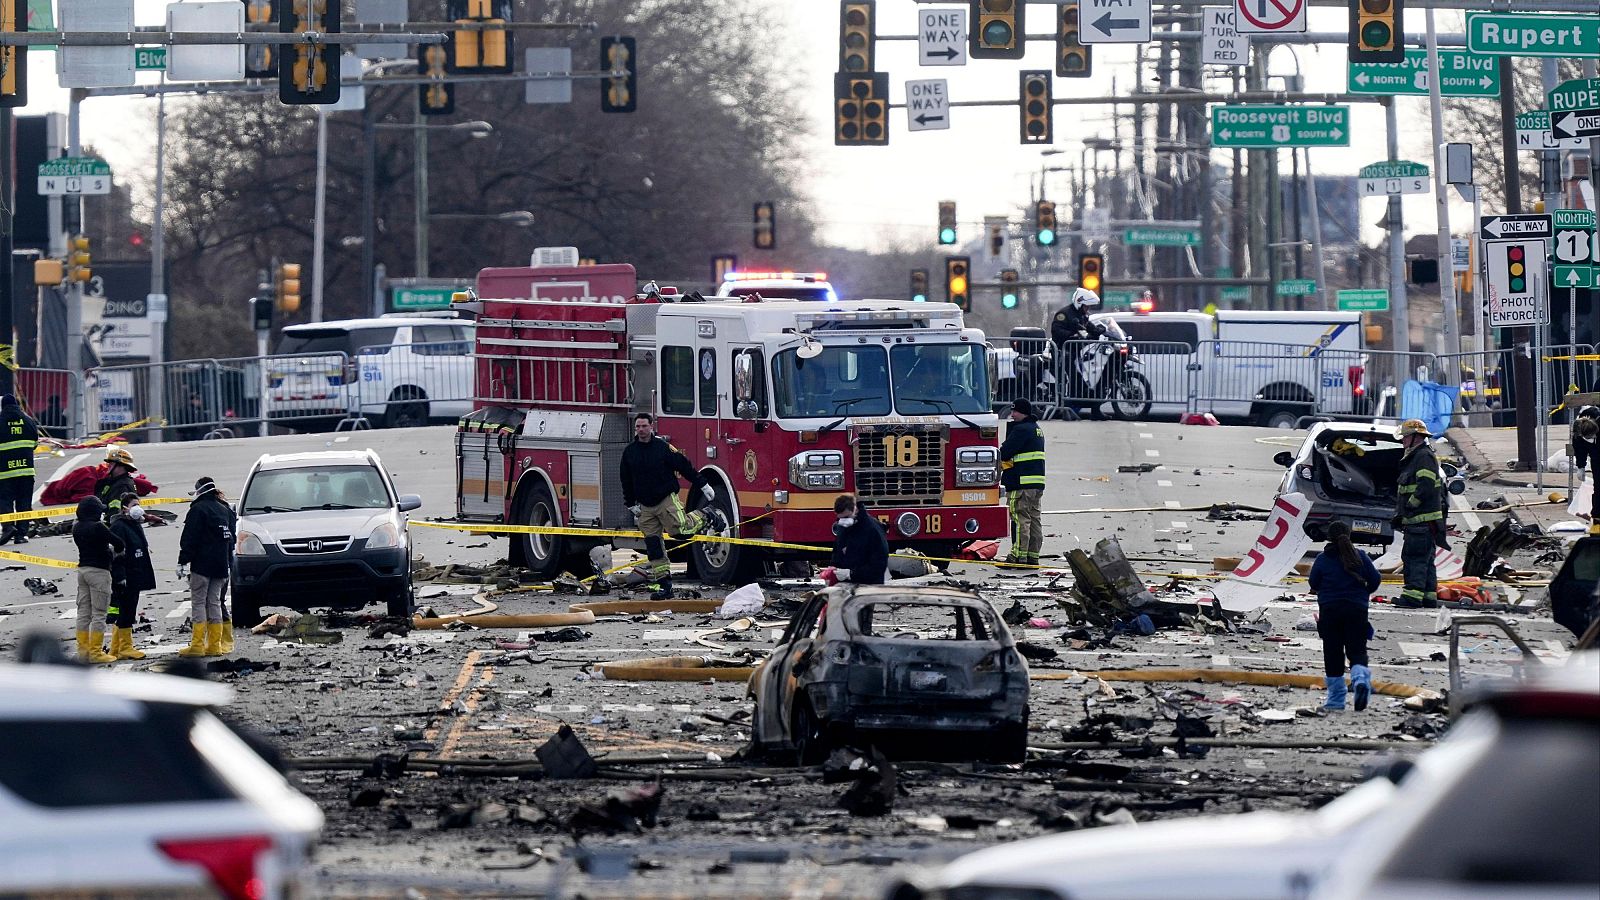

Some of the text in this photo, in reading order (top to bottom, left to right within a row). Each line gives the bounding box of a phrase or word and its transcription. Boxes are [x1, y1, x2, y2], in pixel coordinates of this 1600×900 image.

[926, 15, 959, 27] ONE
[926, 30, 961, 43] WAY
[1482, 22, 1582, 49] Rupert
[1218, 39, 1234, 48] ON
[1214, 51, 1238, 60] RED
[1453, 55, 1493, 70] Blvd
[1373, 75, 1476, 86] NORTH 1 SOUTH
[912, 83, 943, 96] ONE
[912, 98, 944, 110] WAY
[1218, 110, 1343, 123] Roosevelt Blvd
[1515, 117, 1552, 129] ROOSE
[1235, 129, 1327, 138] NORTH 1 SOUTH
[1520, 134, 1530, 144] N
[38, 163, 93, 176] ROOSEVELT
[1360, 166, 1412, 177] ROOSEVELT
[46, 180, 55, 190] N
[1366, 182, 1375, 192] N
[1414, 180, 1422, 190] S
[1557, 213, 1589, 223] NORTH
[1501, 221, 1545, 232] ONE WAY
[1567, 235, 1576, 257] 1
[364, 372, 382, 382] 911
[1322, 378, 1343, 387] 911
[882, 435, 919, 467] 18
[7, 459, 28, 468] BEALE
[961, 493, 986, 502] 195014
[925, 514, 942, 534] 18
